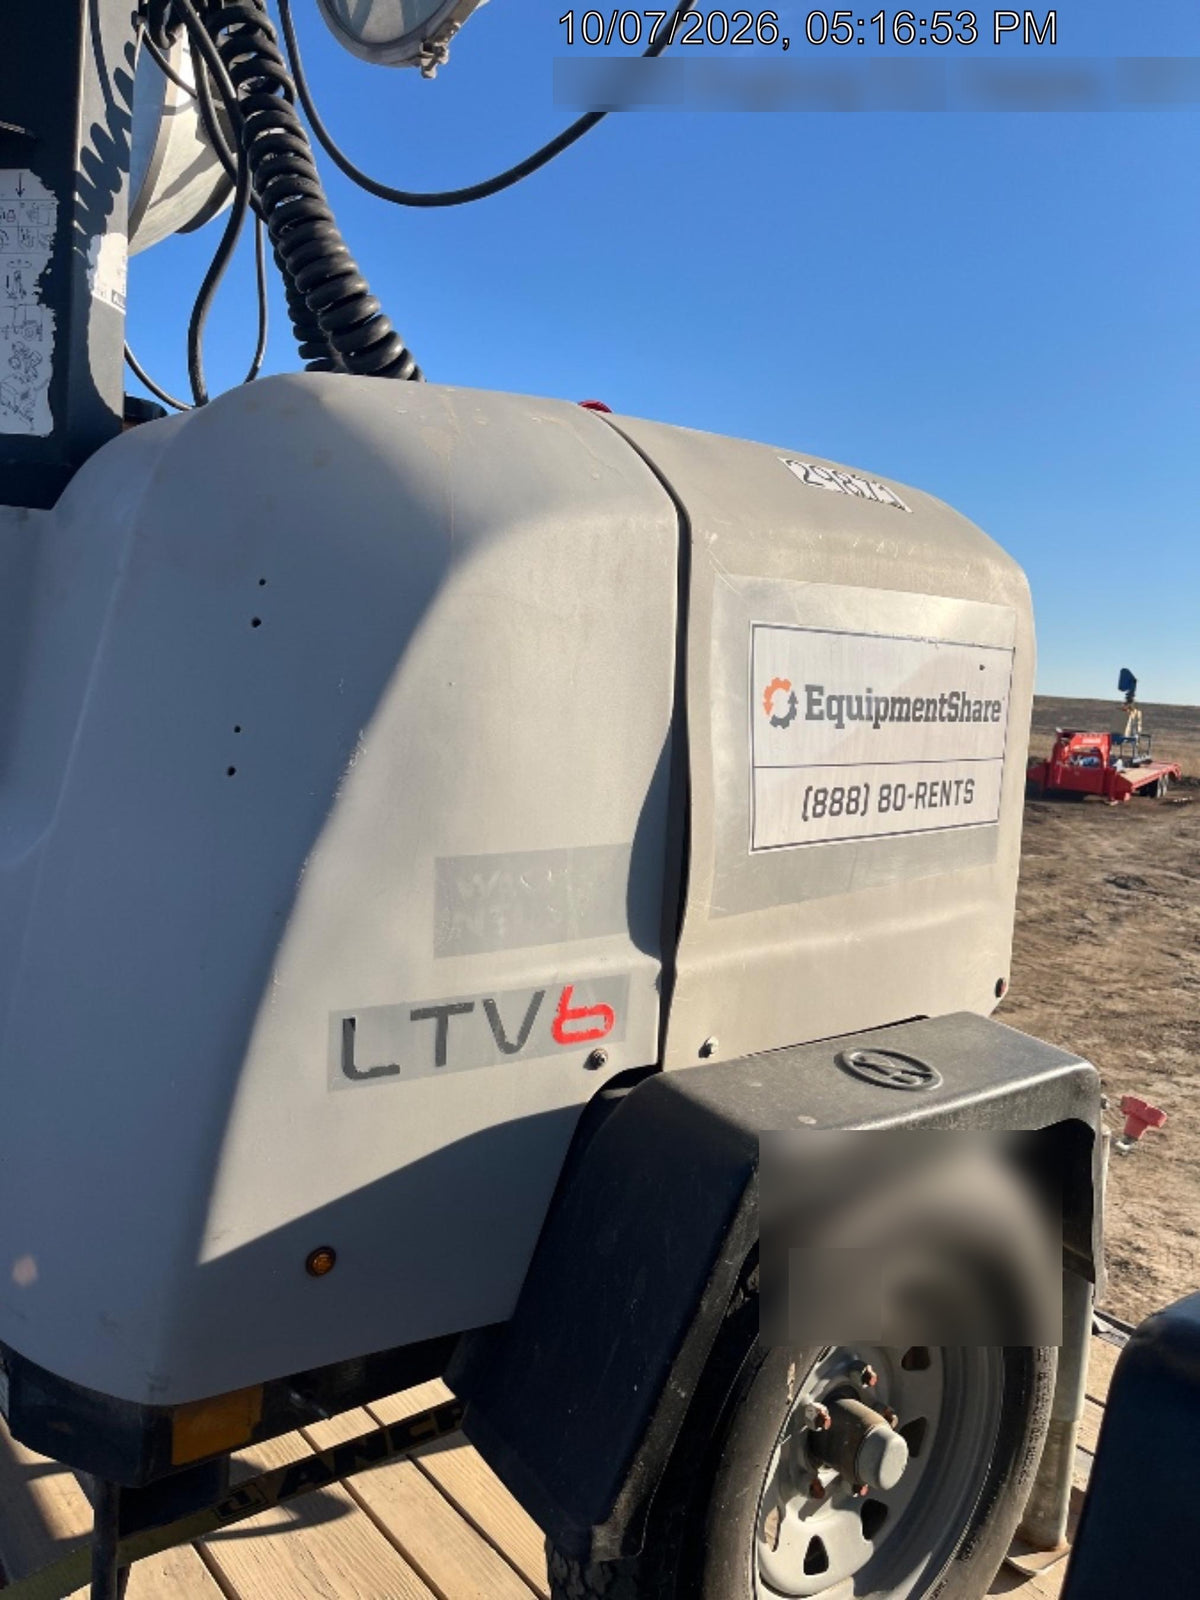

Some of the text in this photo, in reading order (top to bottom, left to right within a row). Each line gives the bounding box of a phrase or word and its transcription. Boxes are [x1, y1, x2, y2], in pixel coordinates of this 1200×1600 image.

[804, 684, 1002, 729] EquipmentShare
[801, 779, 976, 822] (888) 80-RENTS
[341, 984, 615, 1080] LTV6
